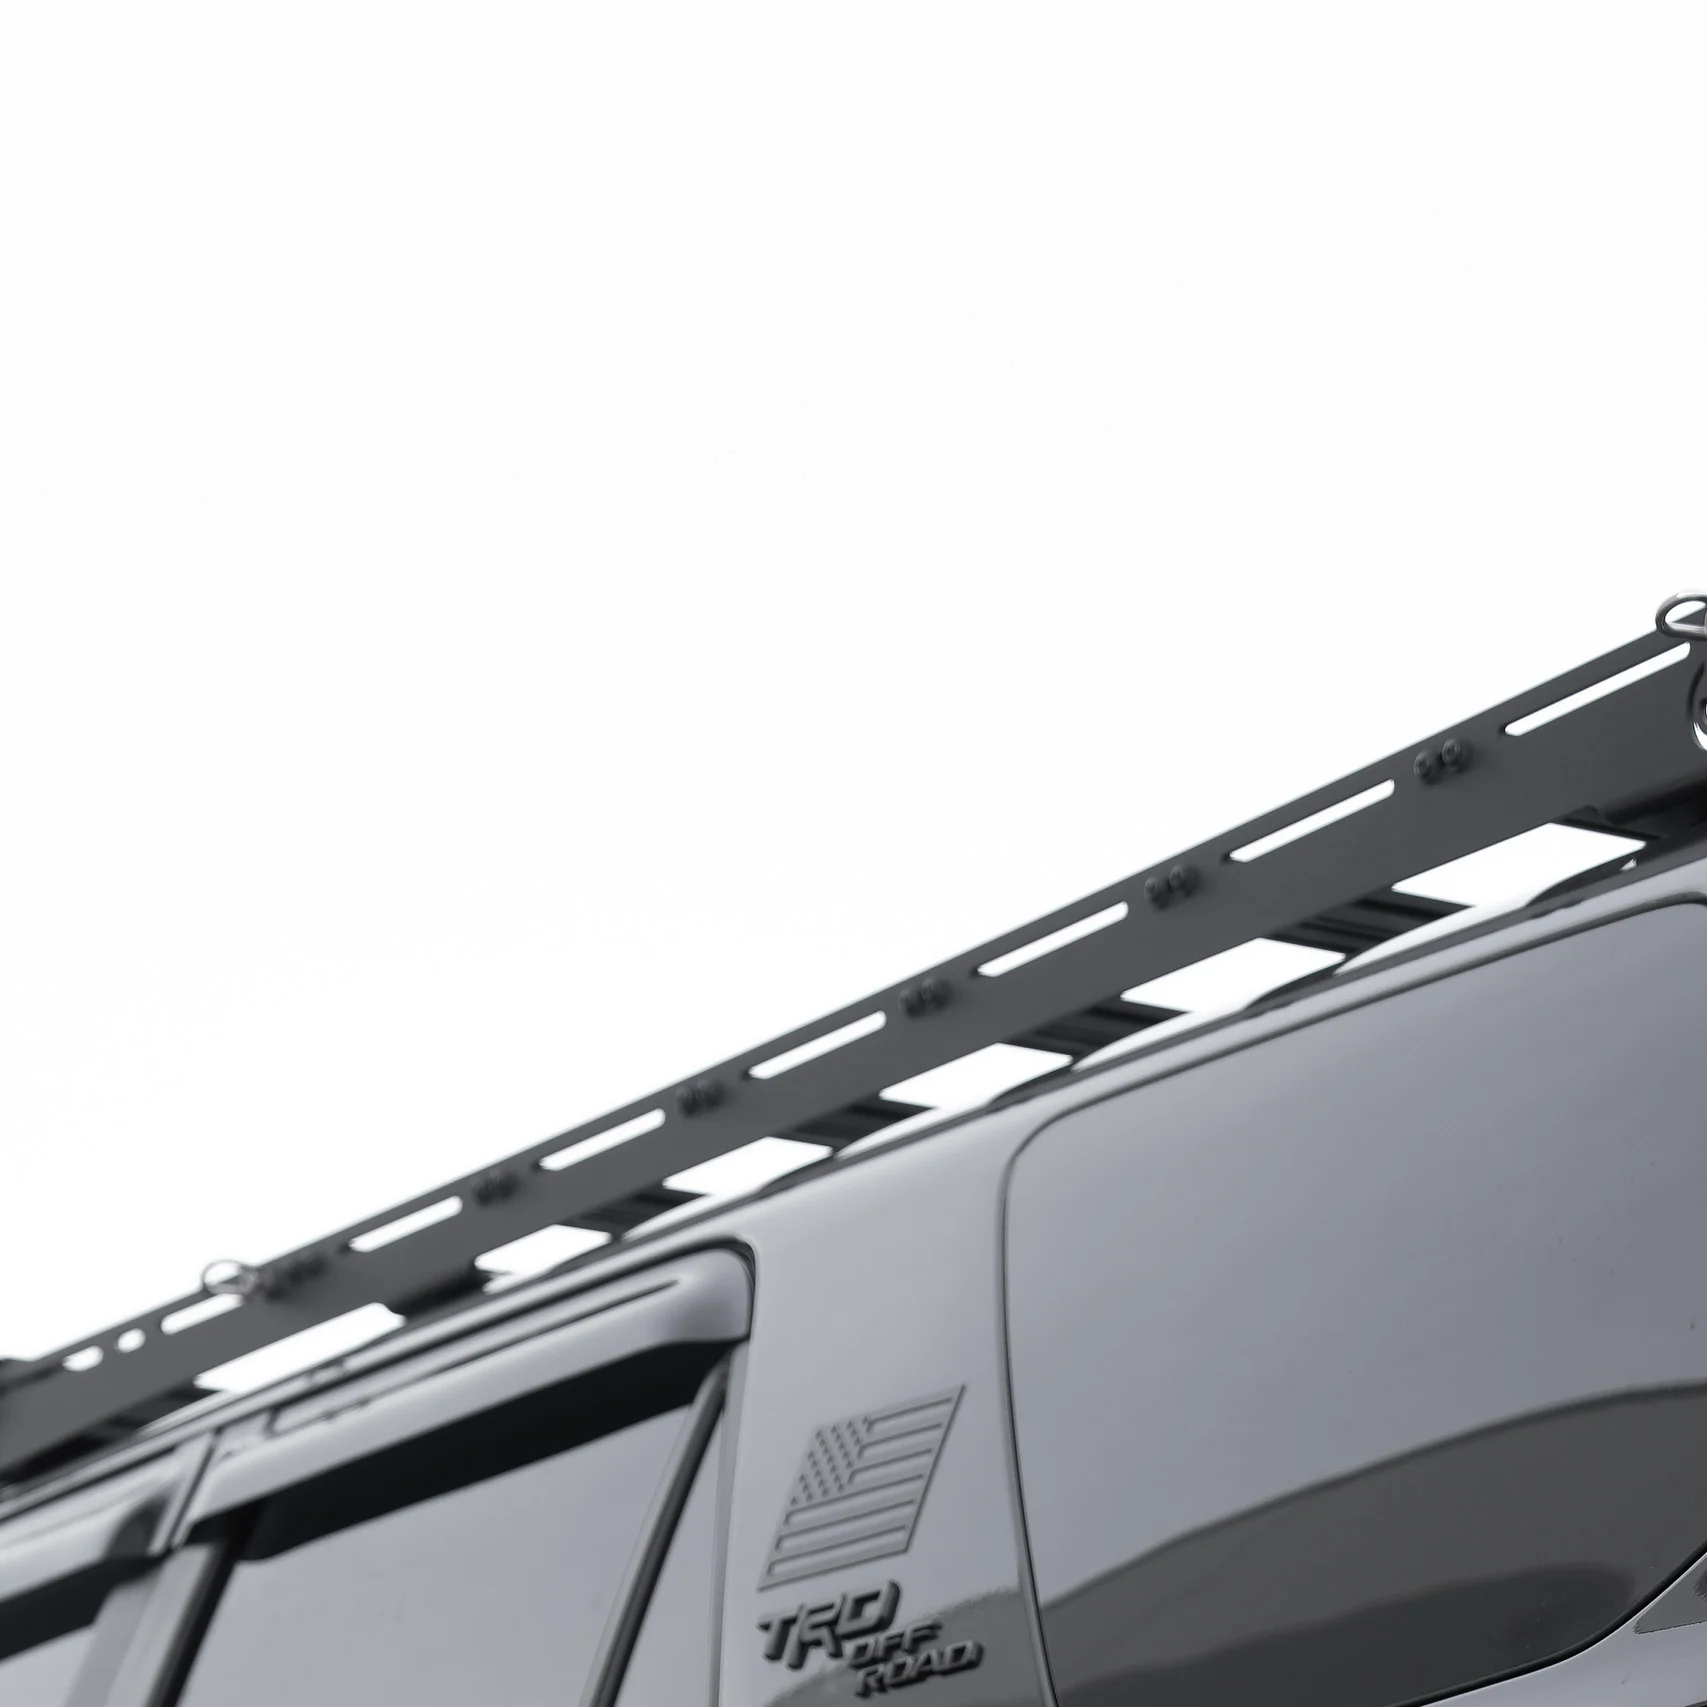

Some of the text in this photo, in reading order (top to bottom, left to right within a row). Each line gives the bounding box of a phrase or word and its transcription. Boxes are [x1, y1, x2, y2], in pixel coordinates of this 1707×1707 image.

[757, 1580, 900, 1669] TRD
[841, 1620, 942, 1668] OFF
[855, 1640, 984, 1698] ROAD
